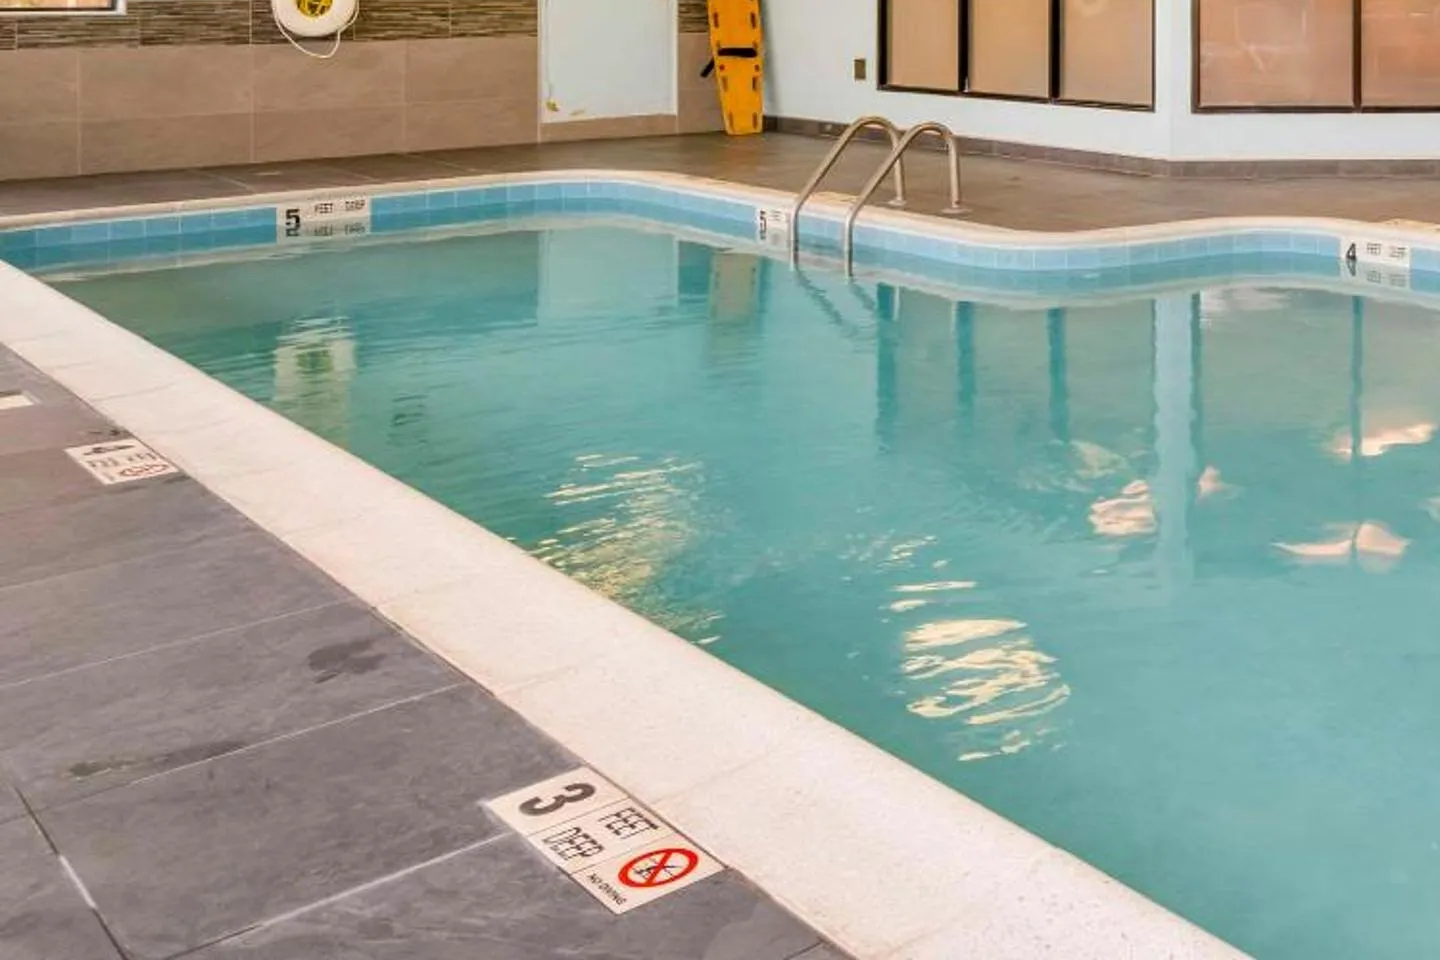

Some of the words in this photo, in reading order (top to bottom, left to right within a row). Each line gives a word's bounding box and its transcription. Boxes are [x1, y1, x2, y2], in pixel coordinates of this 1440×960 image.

[286, 209, 300, 228] 5
[1346, 243, 1356, 260] 4
[518, 783, 596, 817] 3
[598, 807, 659, 840] FEET
[541, 826, 605, 861] DEEP
